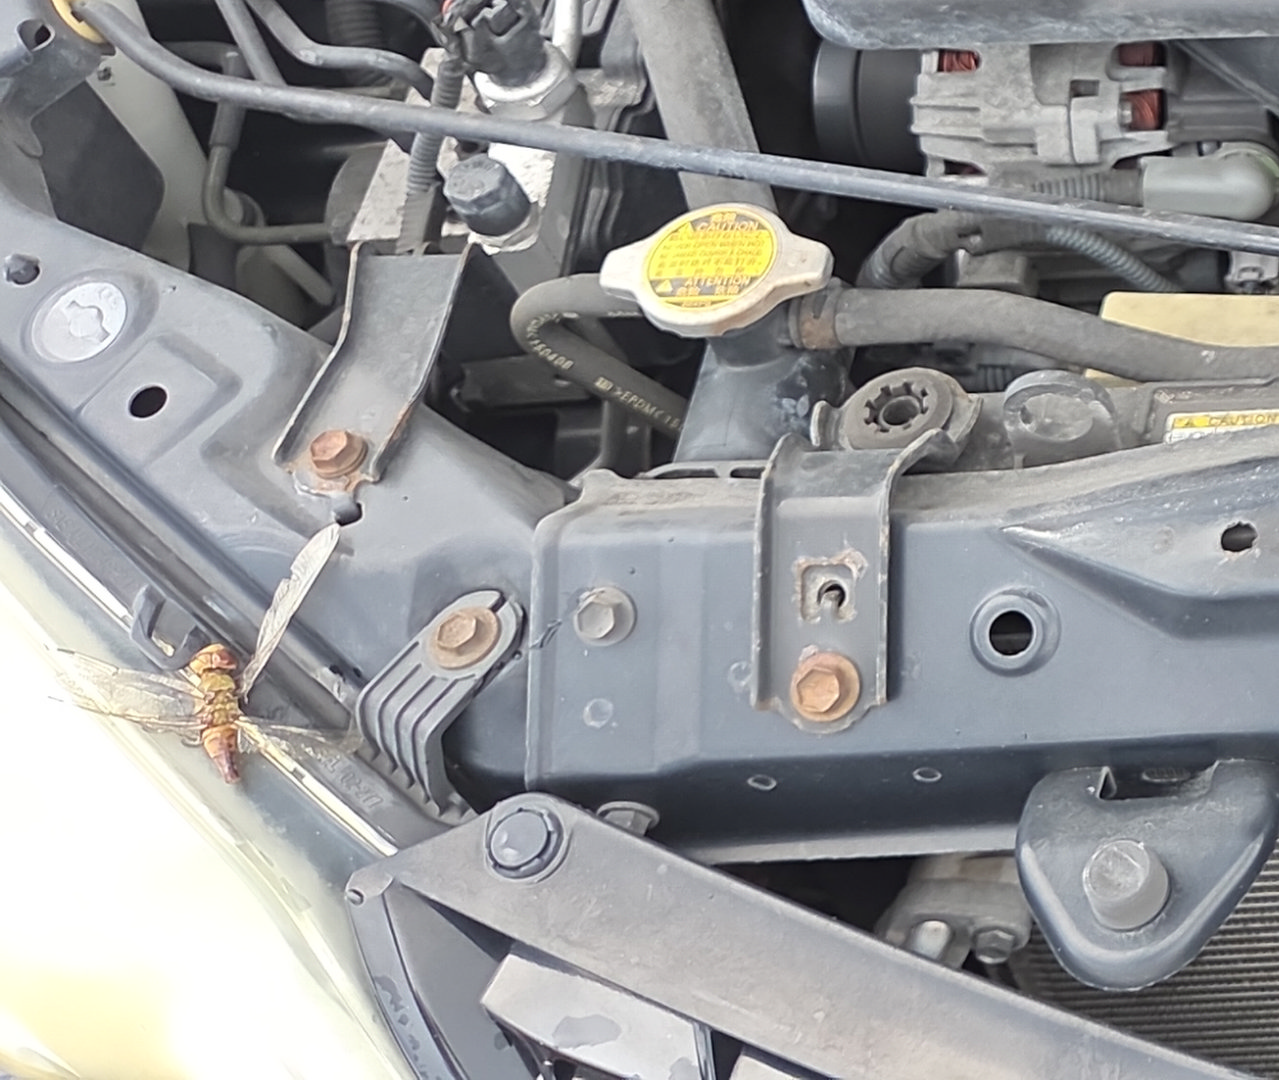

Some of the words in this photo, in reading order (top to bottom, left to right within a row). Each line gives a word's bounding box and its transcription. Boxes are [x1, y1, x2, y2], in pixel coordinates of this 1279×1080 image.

[697, 221, 760, 232] CAUTION
[684, 276, 751, 286] ATTENTION
[1207, 414, 1278, 427] CAUTION
